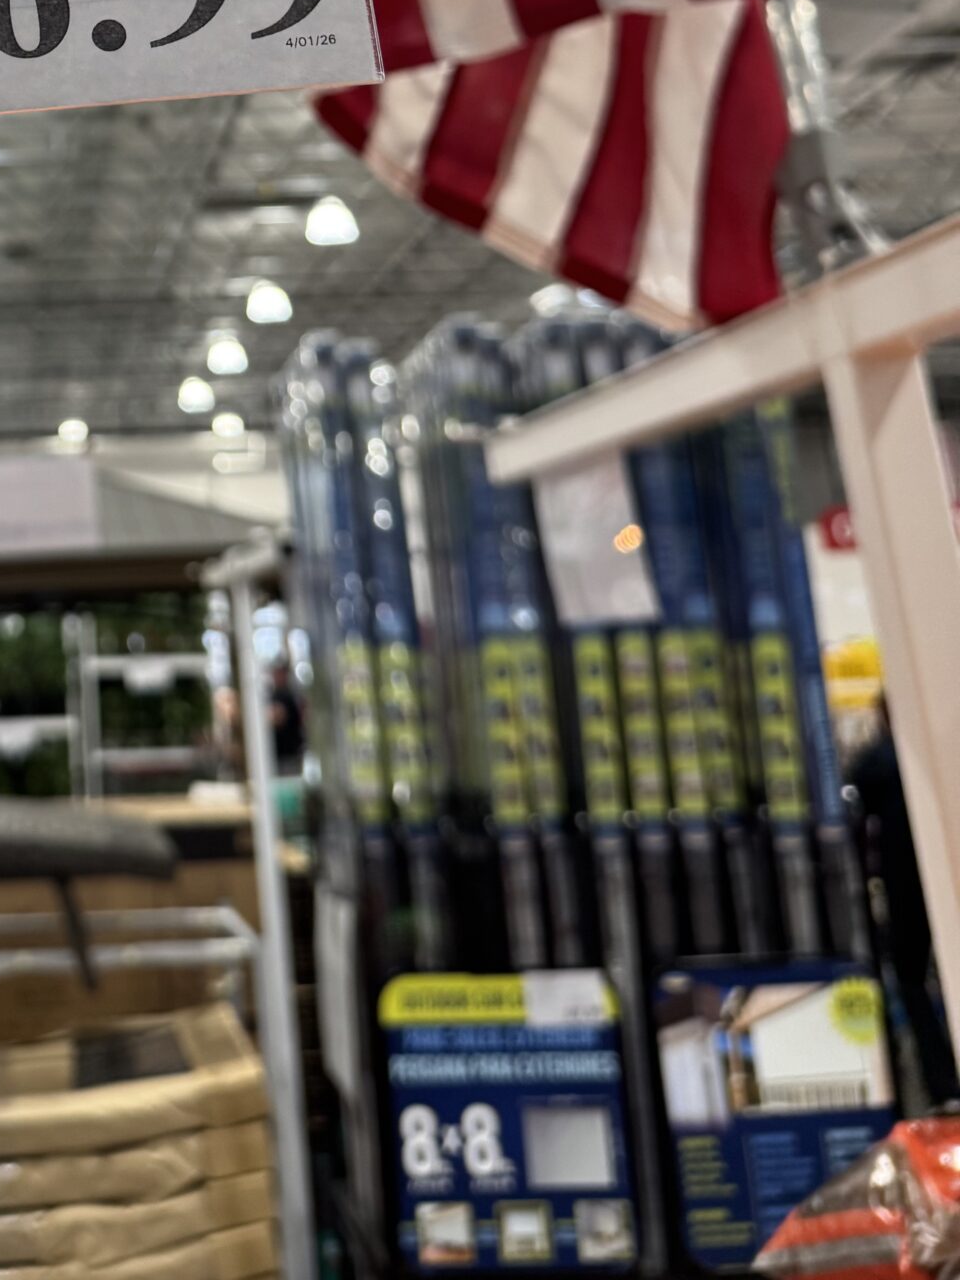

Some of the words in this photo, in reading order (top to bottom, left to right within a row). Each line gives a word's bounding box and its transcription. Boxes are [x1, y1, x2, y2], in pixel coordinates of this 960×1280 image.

[285, 33, 337, 48] 4/01/26
[399, 1103, 438, 1178] 8
[461, 1102, 501, 1177] 8
